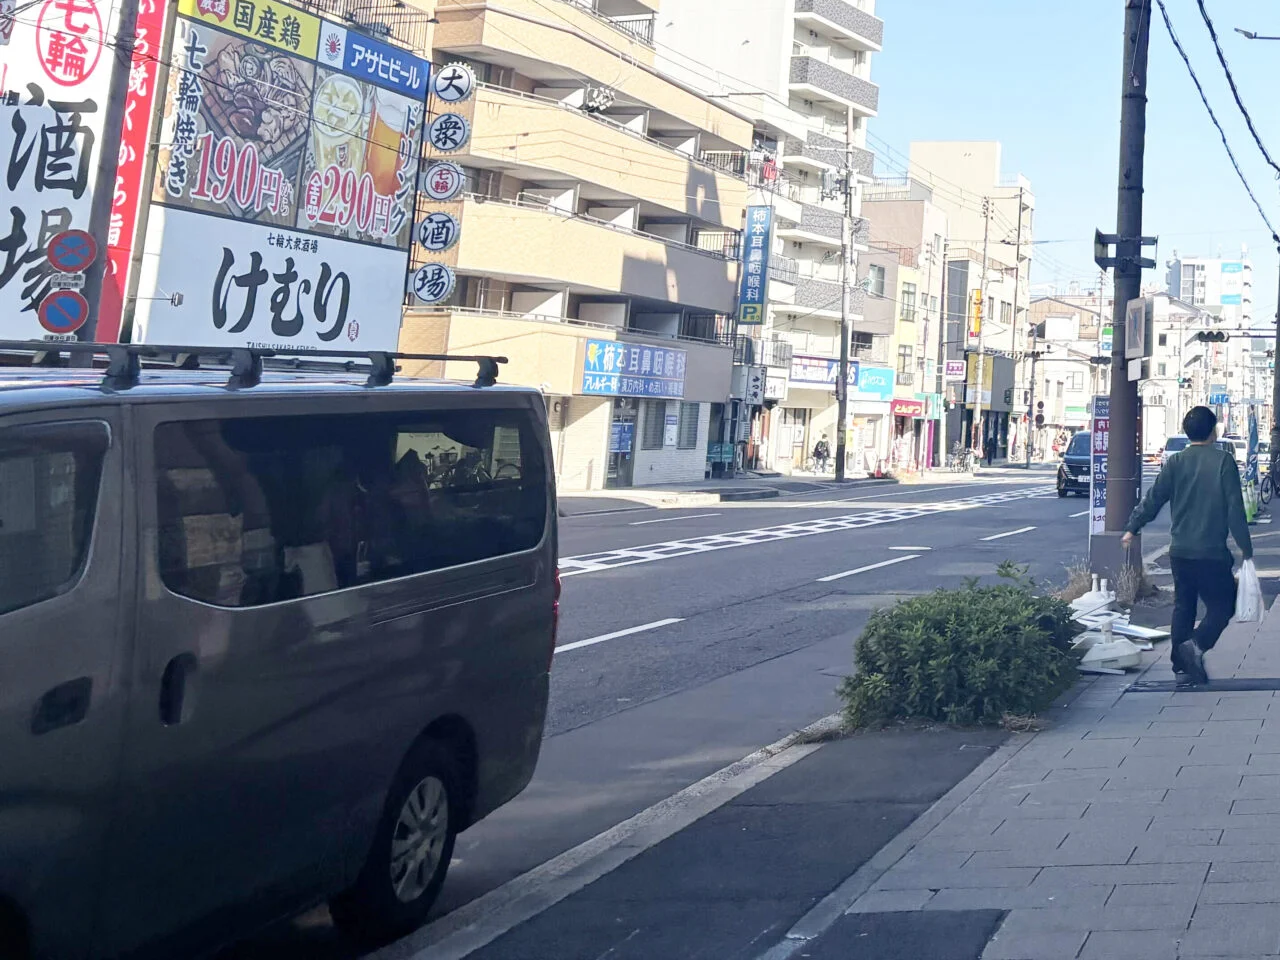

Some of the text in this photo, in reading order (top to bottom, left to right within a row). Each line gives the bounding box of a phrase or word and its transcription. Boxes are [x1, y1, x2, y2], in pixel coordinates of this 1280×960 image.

[166, 29, 208, 197] 七輪焼き
[351, 43, 420, 90] アサヒビール
[318, 165, 393, 237] 290円
[391, 105, 419, 236] ドリンク
[267, 232, 319, 254] 七輪大衆酒場
[745, 208, 767, 302] 柿本耳鼻咽喉科
[212, 246, 351, 341] けむり
